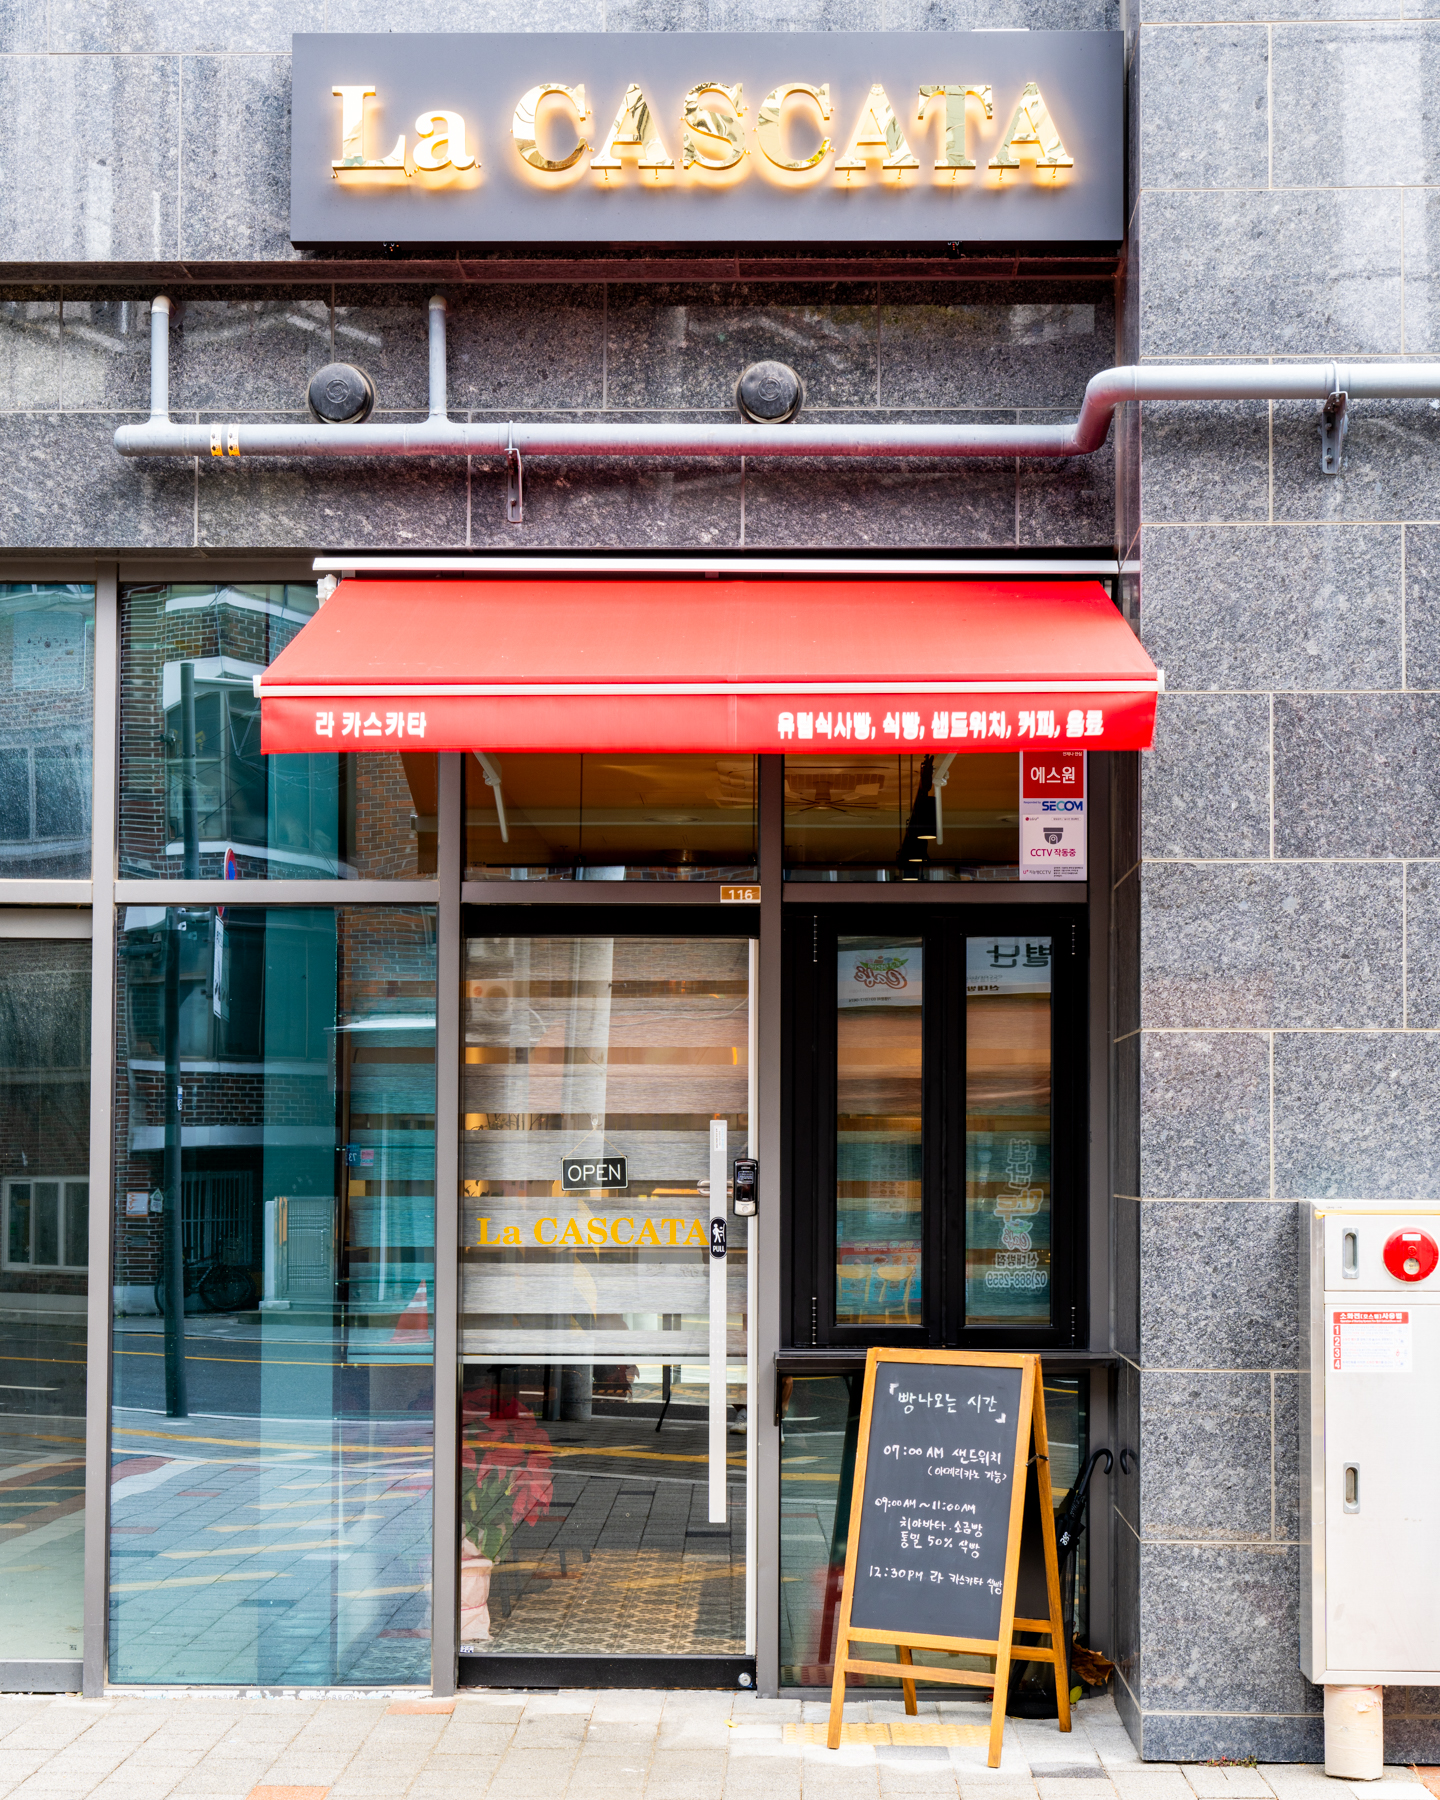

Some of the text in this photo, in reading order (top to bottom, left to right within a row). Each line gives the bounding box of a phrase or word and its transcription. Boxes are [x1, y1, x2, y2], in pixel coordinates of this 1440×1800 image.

[331, 82, 1075, 174] La CASCATA
[315, 711, 427, 738] 라 카스카타
[1030, 766, 1076, 784] 에스원
[1042, 800, 1083, 811] SECOM
[1030, 848, 1077, 858] CCTV 작동중
[728, 889, 753, 901] 116
[567, 1163, 621, 1182] OPEN
[476, 1217, 710, 1245] La CASCATA
[712, 1245, 725, 1253] PULL
[1334, 1325, 1340, 1335] 1
[1334, 1337, 1340, 1346] 2
[1334, 1348, 1340, 1358] 3
[1334, 1359, 1340, 1369] 4
[952, 1448, 1002, 1466] 샌드위치
[900, 1530, 922, 1549] 통밀
[927, 1535, 953, 1548] 50%
[948, 1572, 984, 1587] 카스카타
